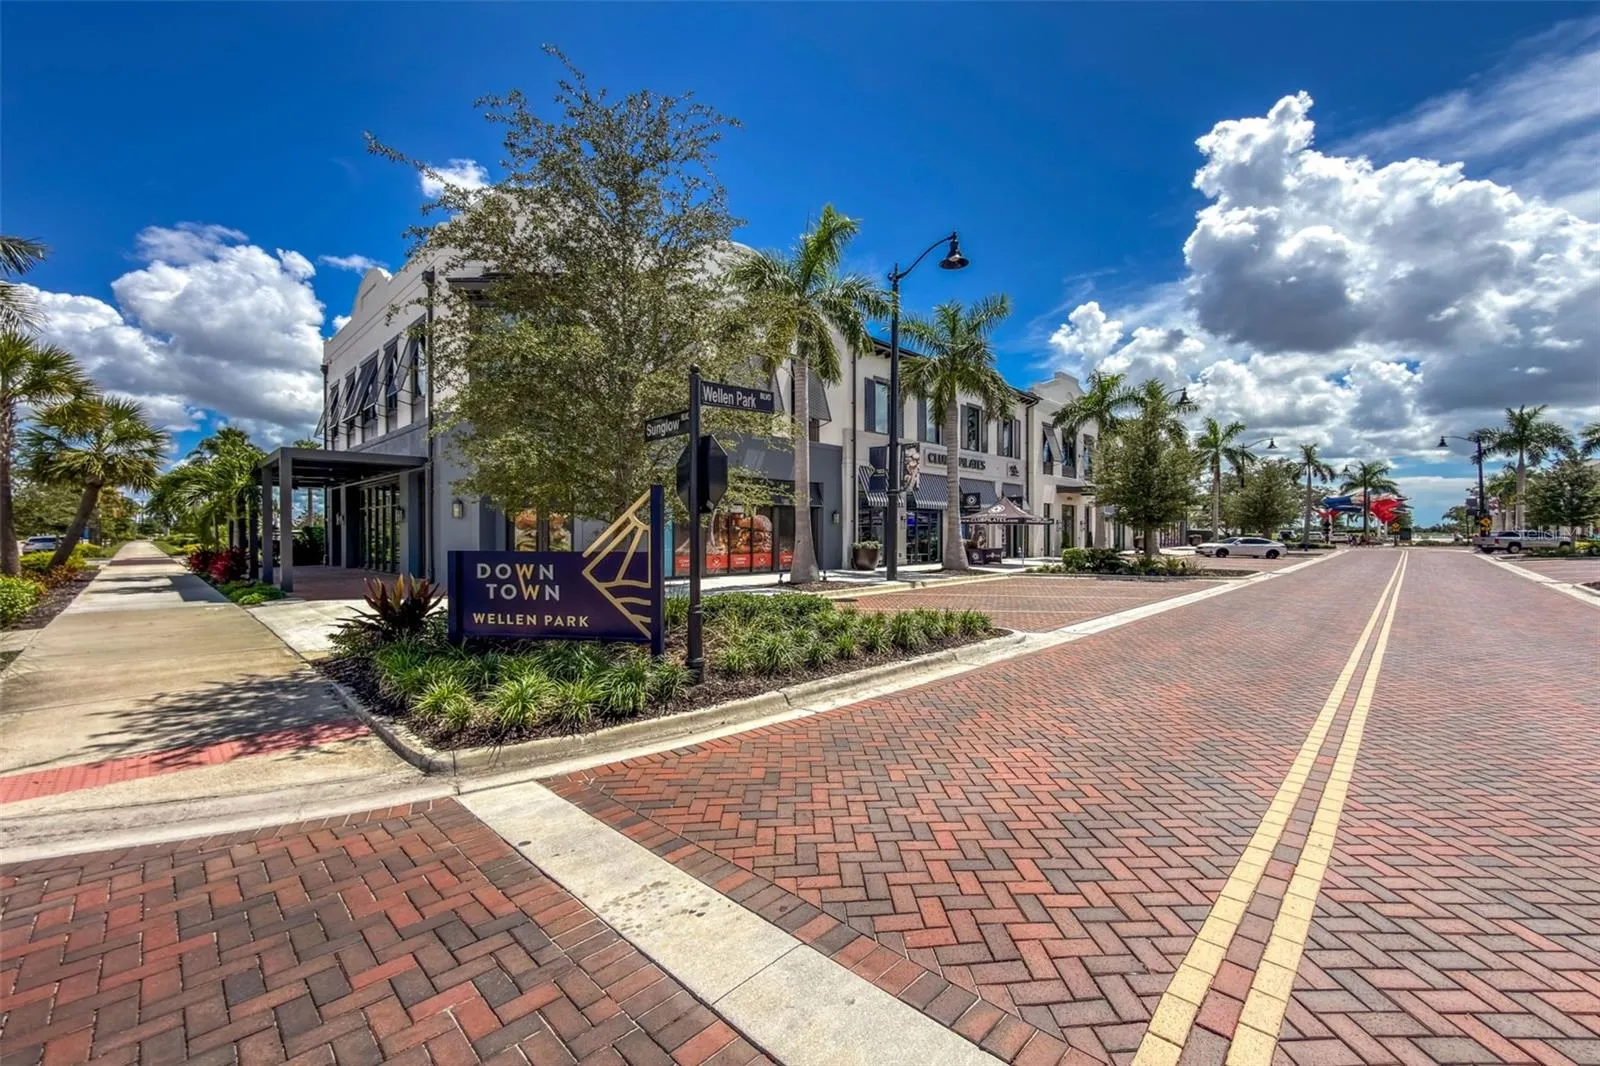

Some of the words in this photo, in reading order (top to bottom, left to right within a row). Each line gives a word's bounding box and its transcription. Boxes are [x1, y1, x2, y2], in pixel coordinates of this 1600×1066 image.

[702, 384, 734, 405] Wellen
[736, 391, 757, 409] Park
[646, 419, 680, 437] Sunglow
[476, 563, 555, 580] DOWN
[485, 583, 561, 601] TOWN
[472, 612, 537, 626] WELLEN
[544, 614, 590, 628] PARK
